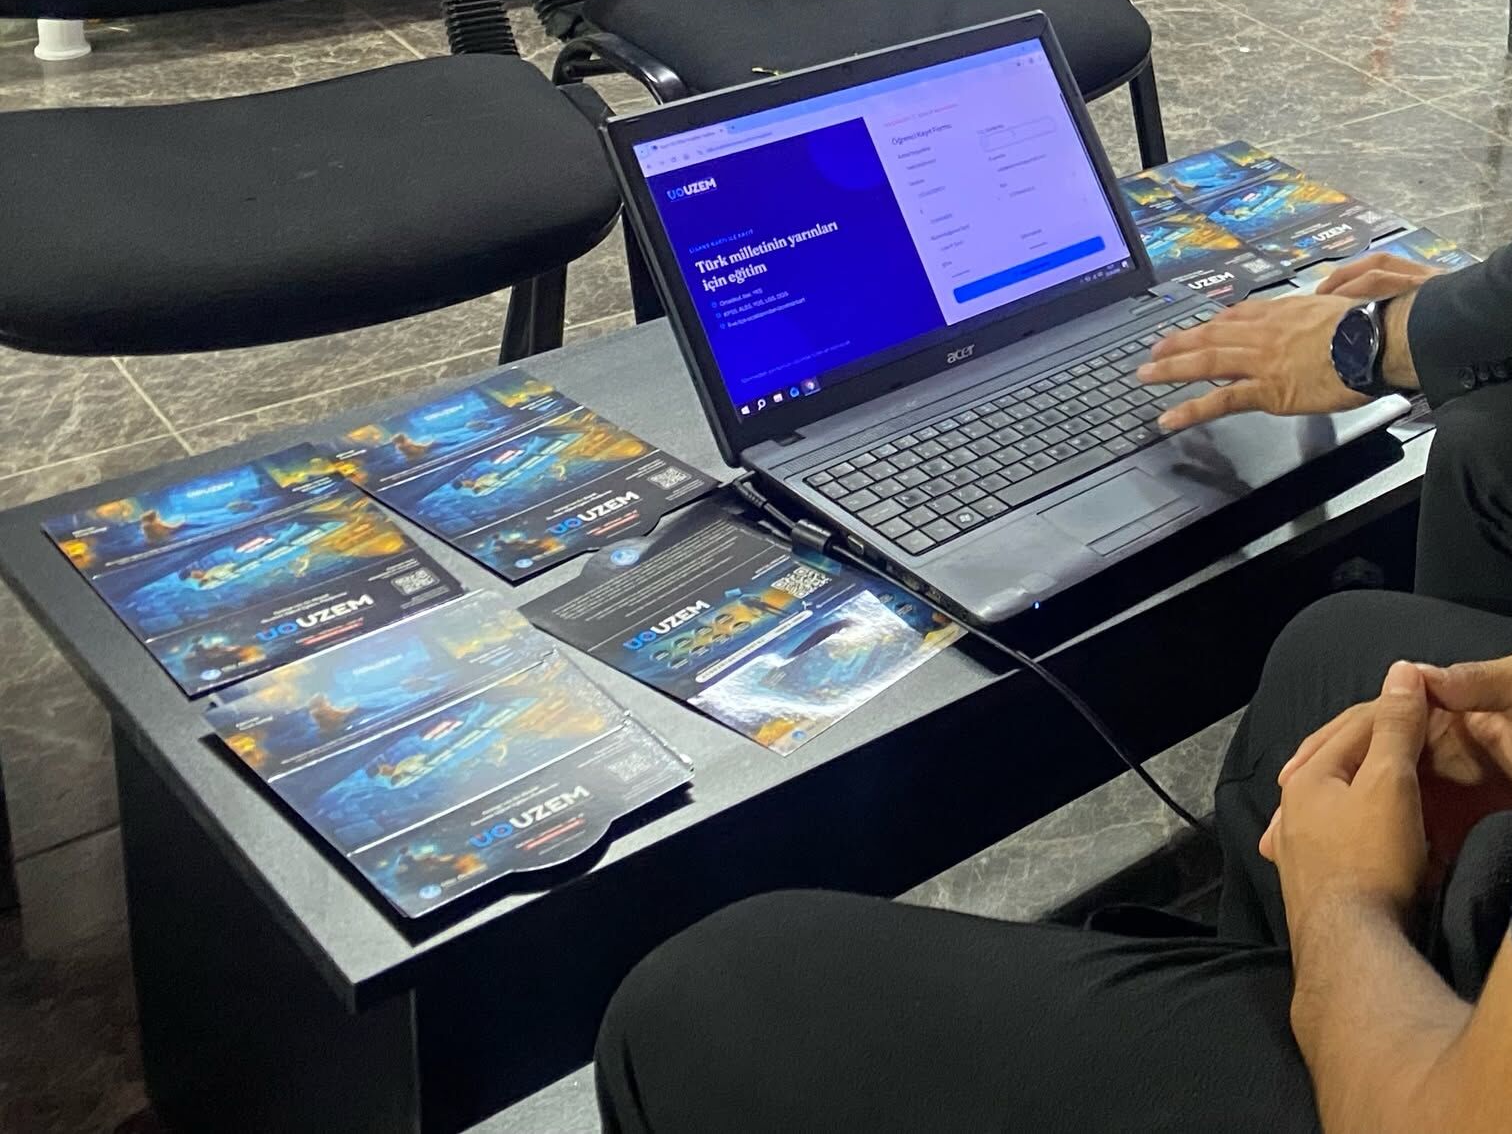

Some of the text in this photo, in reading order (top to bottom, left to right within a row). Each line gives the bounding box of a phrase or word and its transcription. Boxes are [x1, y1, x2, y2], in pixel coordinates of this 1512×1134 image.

[695, 221, 839, 274] Türk milletinin yarınları
[702, 262, 768, 292] için eğitim
[1187, 271, 1235, 290] UZEM
[947, 343, 975, 363] acer
[545, 490, 640, 534] UOUZEM
[255, 594, 374, 642] UOUZEM
[622, 600, 711, 651] UOUZEM
[468, 785, 590, 848] UOUZEM
